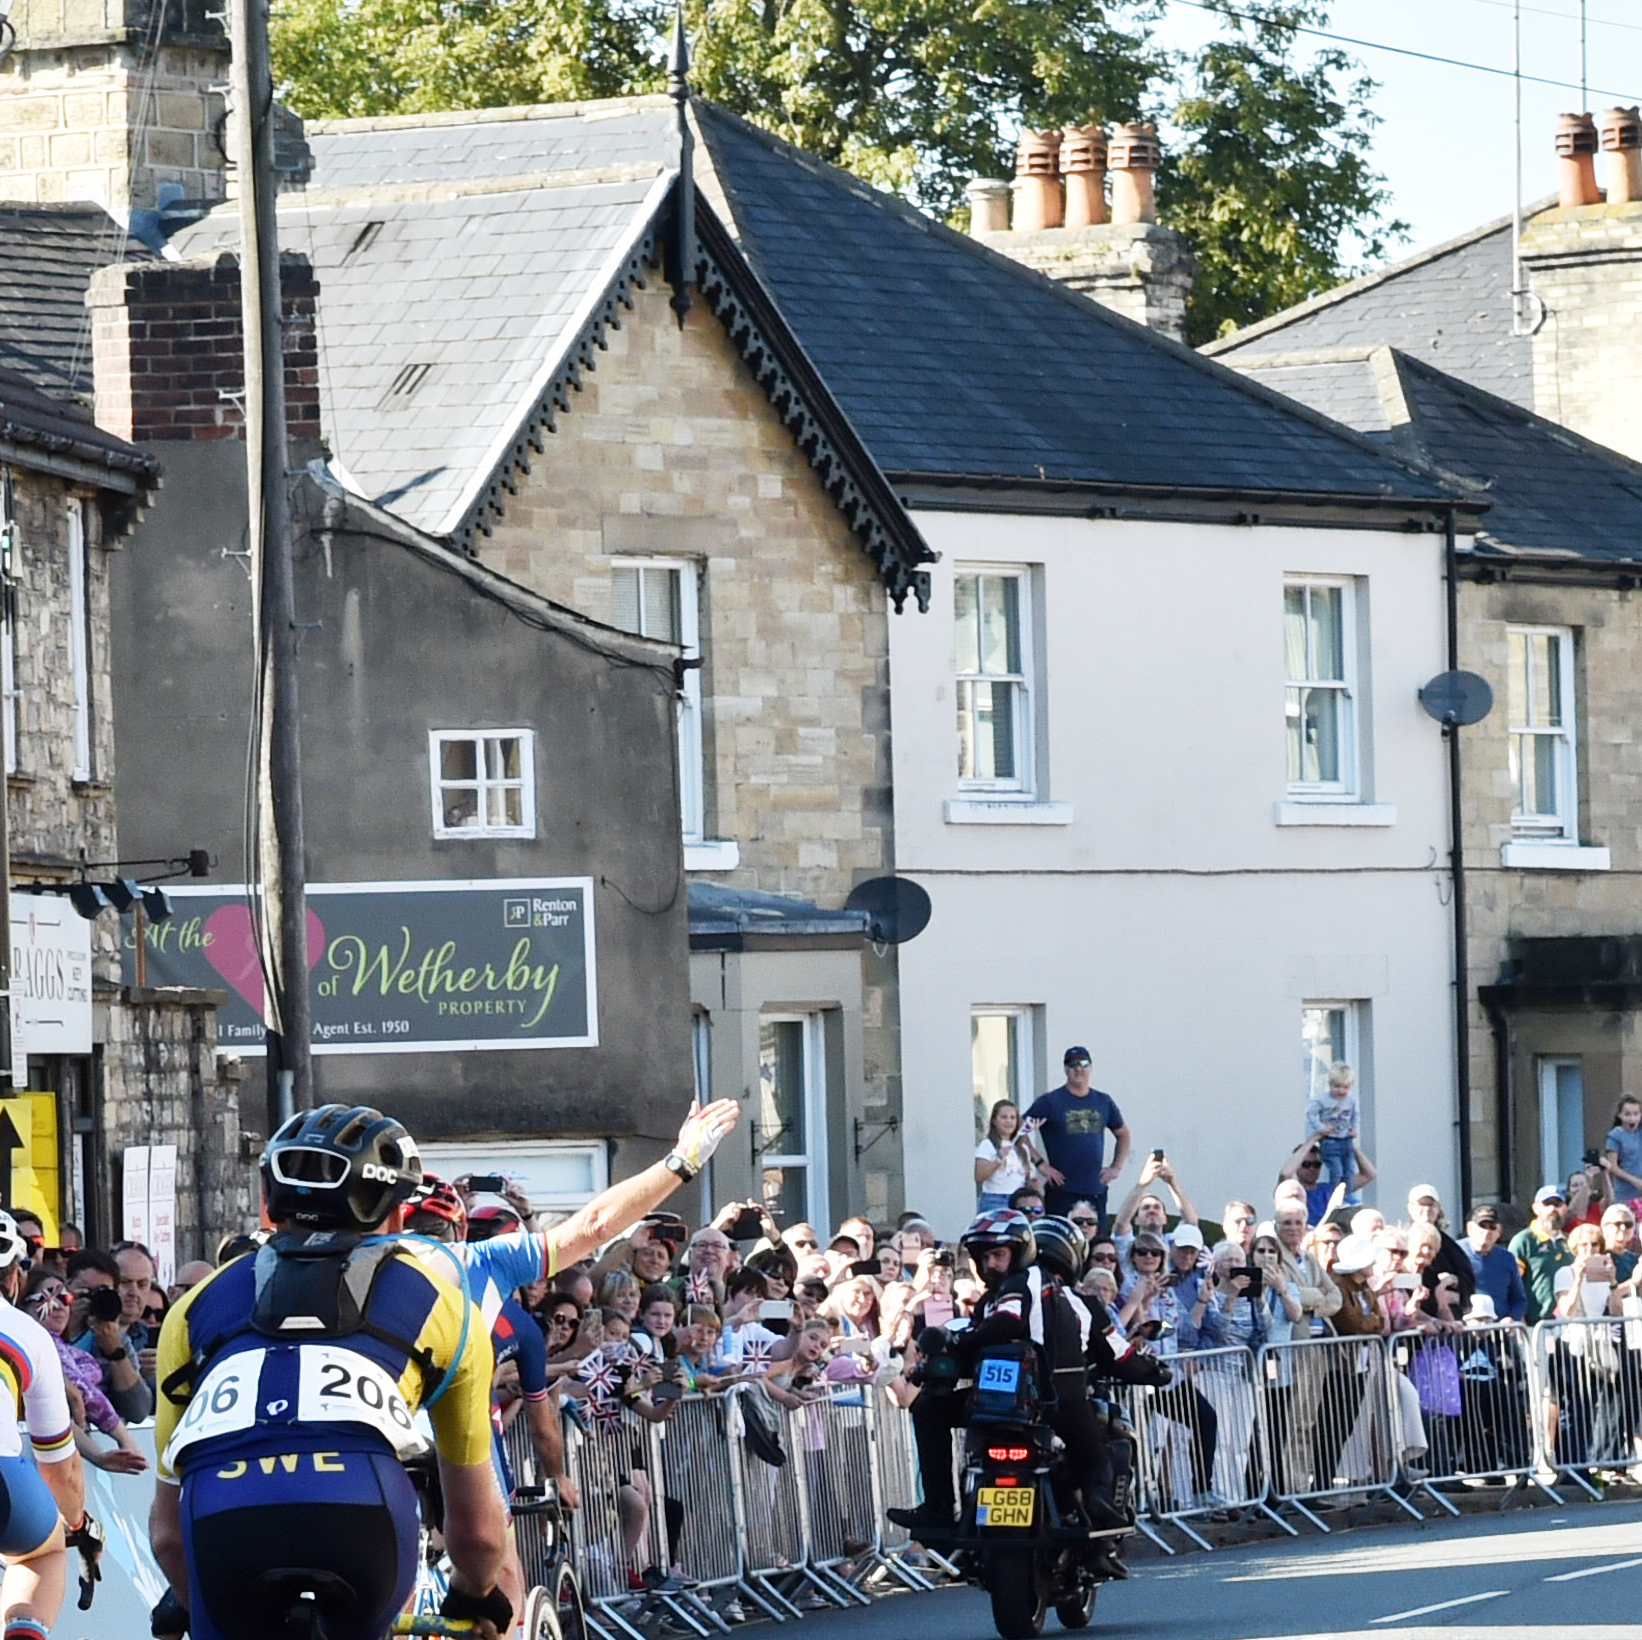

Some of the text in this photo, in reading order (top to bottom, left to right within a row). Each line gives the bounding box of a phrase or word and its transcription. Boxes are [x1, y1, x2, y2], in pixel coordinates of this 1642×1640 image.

[533, 898, 577, 912] Renton
[533, 912, 569, 927] &Parr
[178, 916, 217, 954] the
[13, 946, 65, 1001] RAGGS
[318, 925, 559, 1029] of Wetherby
[438, 1000, 527, 1016] PROPERTY
[313, 1021, 350, 1039] Agent
[354, 1020, 377, 1035] Est.
[382, 1020, 410, 1034] 1950
[362, 1162, 399, 1185] POC
[985, 1366, 1013, 1383] 515
[179, 1375, 240, 1433] 06
[319, 1364, 412, 1431] 206
[217, 1451, 346, 1479] SWE
[980, 1490, 1032, 1506] LG68
[990, 1508, 1029, 1523] GHN
